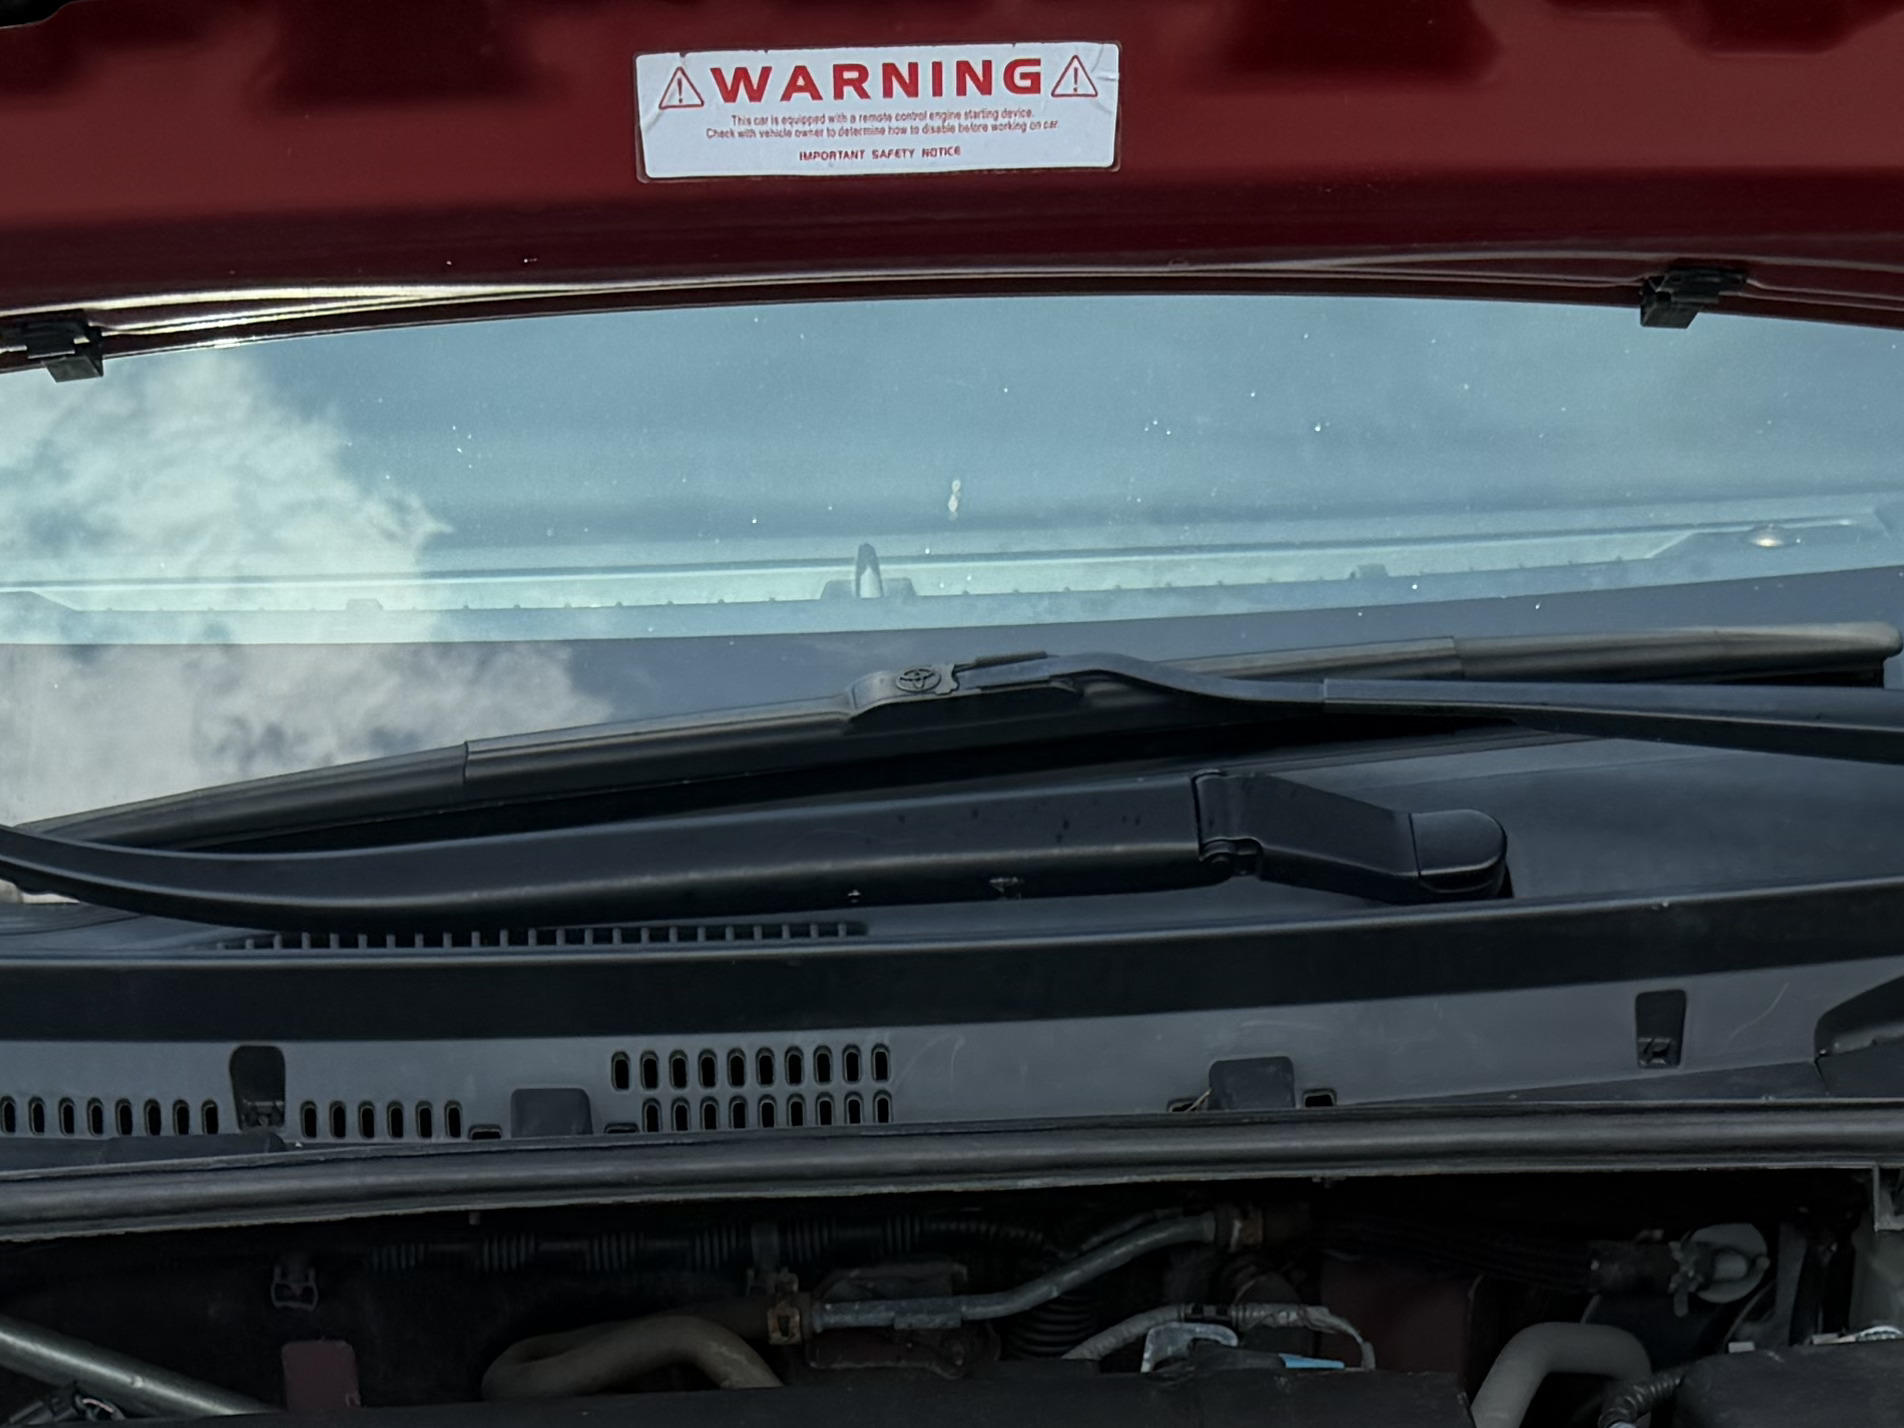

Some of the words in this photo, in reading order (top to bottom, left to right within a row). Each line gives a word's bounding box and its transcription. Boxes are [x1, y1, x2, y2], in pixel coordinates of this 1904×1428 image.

[709, 57, 1042, 104] WARNING
[731, 114, 752, 126] This
[754, 115, 769, 126] car
[771, 114, 779, 126] is
[781, 114, 826, 128] equipped
[828, 112, 847, 124] with
[850, 114, 856, 124] a
[859, 112, 892, 123] remote
[895, 110, 928, 122] control
[929, 111, 962, 124] engine
[964, 109, 1000, 122] starting
[706, 127, 736, 139] Check
[738, 127, 757, 138] with
[759, 127, 792, 138] vehicle
[794, 128, 824, 138] owner
[826, 127, 837, 138] to
[838, 126, 886, 137] determine
[888, 125, 907, 135] how
[910, 124, 920, 135] to
[922, 122, 956, 135] disable
[958, 121, 988, 133] before
[991, 120, 1028, 133] working
[1029, 120, 1042, 131] on
[799, 149, 866, 161] IMPORTANT
[871, 147, 916, 160] SAFETY
[921, 145, 962, 158] NOTICE
